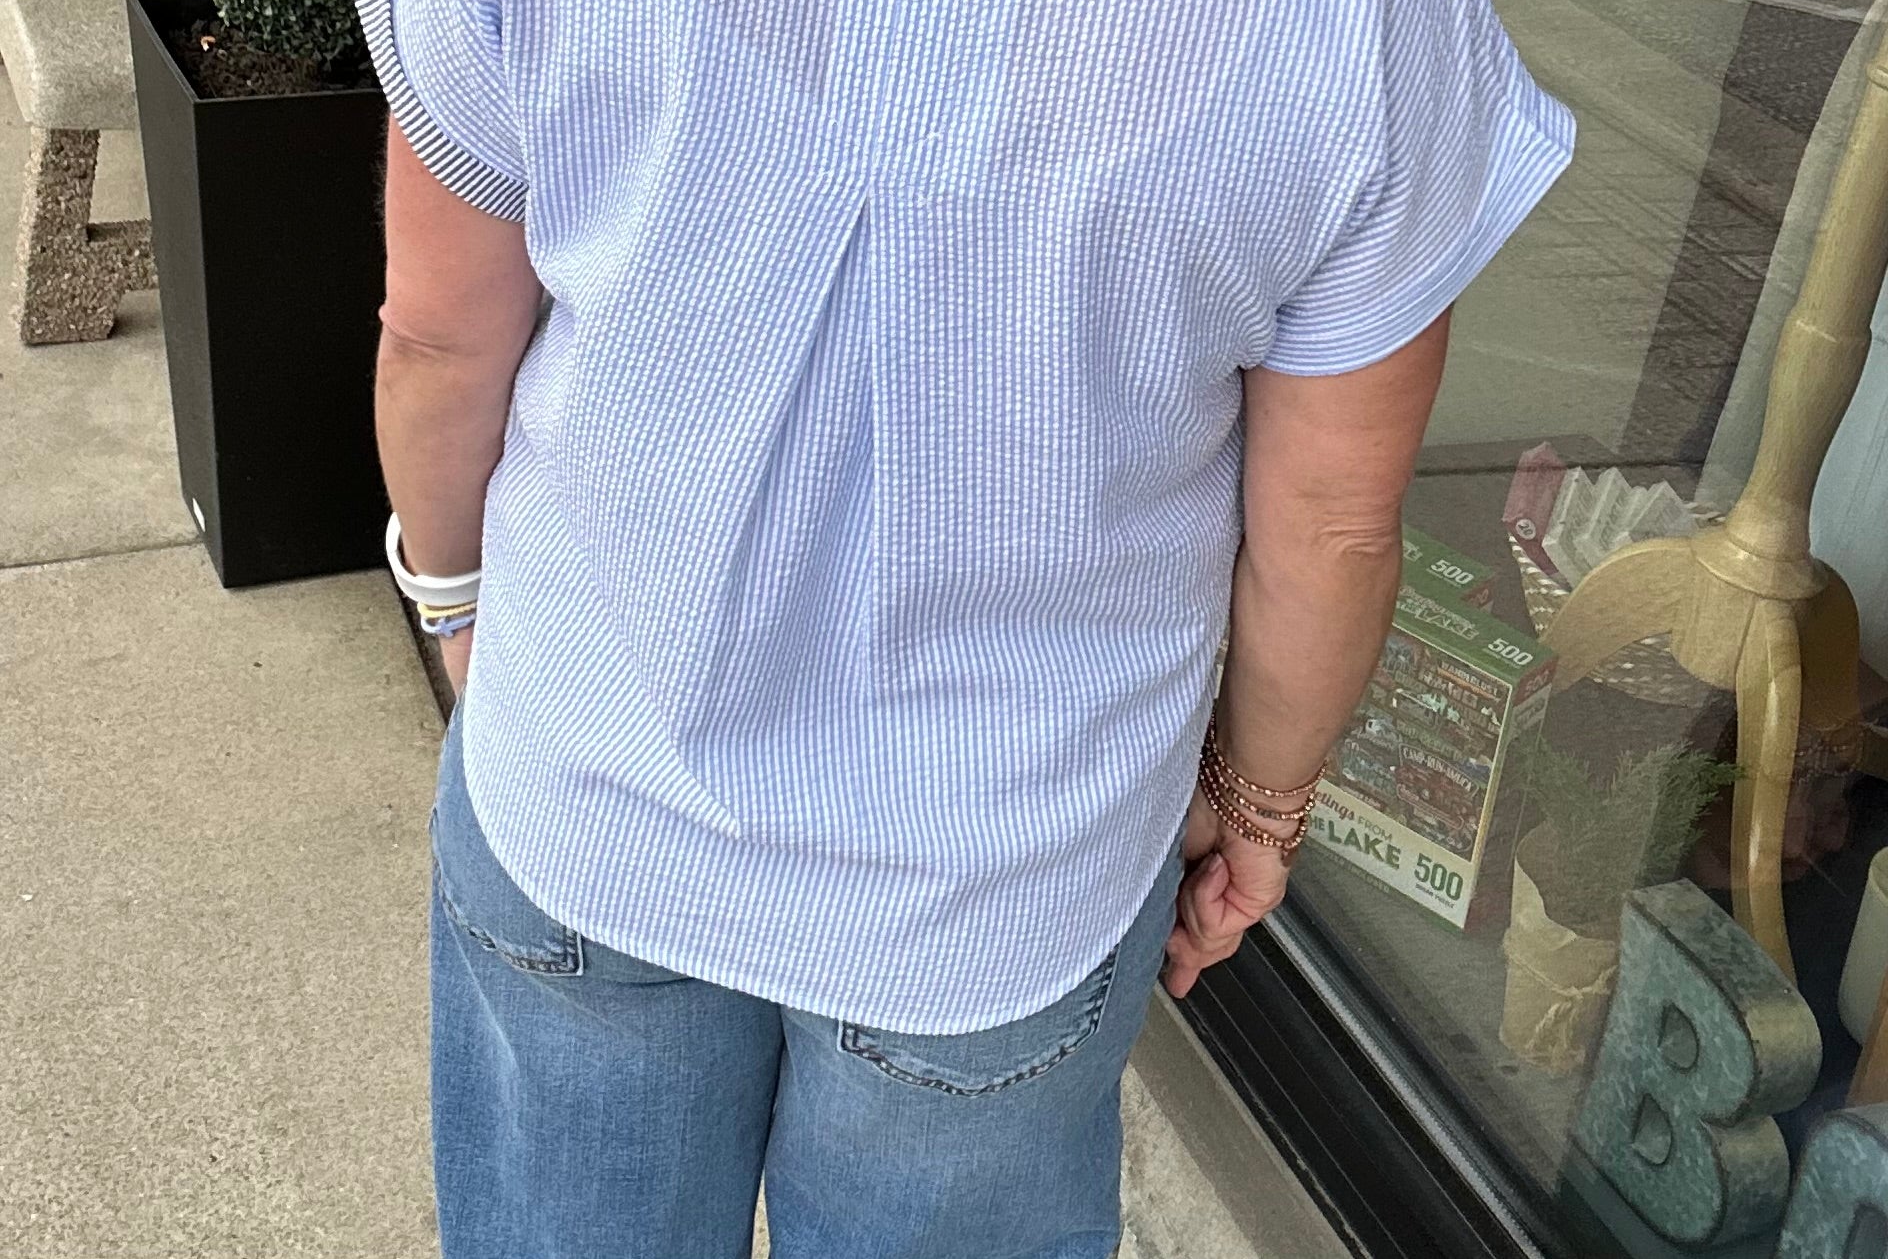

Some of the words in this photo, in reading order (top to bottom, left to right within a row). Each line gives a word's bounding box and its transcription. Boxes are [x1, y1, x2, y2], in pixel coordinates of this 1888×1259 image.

[1430, 558, 1474, 586] 500
[1487, 637, 1533, 668] 500
[1316, 788, 1355, 823] etings
[1357, 814, 1393, 842] FROM
[1326, 819, 1401, 870] LAKE
[1413, 852, 1464, 902] 500
